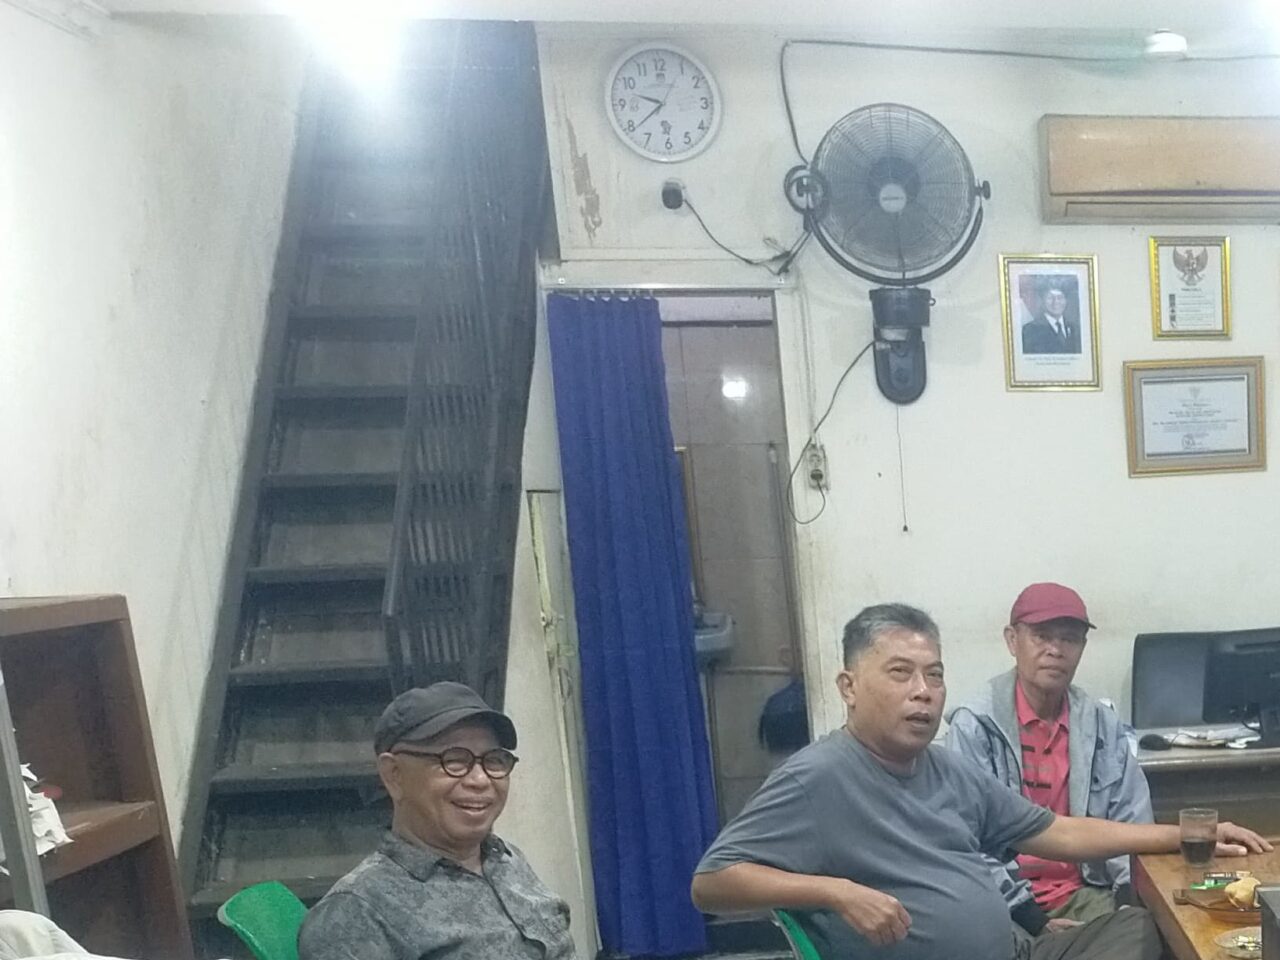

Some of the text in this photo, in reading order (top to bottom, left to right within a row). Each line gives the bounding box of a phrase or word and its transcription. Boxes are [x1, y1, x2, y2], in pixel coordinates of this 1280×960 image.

[637, 62, 647, 76] 11
[653, 58, 666, 71] 12
[622, 76, 636, 90] 10
[692, 75, 701, 89] 2
[618, 98, 626, 111] 9
[700, 97, 709, 110] 3
[627, 119, 636, 132] 8
[697, 119, 705, 131] 4
[643, 132, 652, 149] 7
[664, 137, 673, 150] 6
[684, 131, 692, 145] 5
